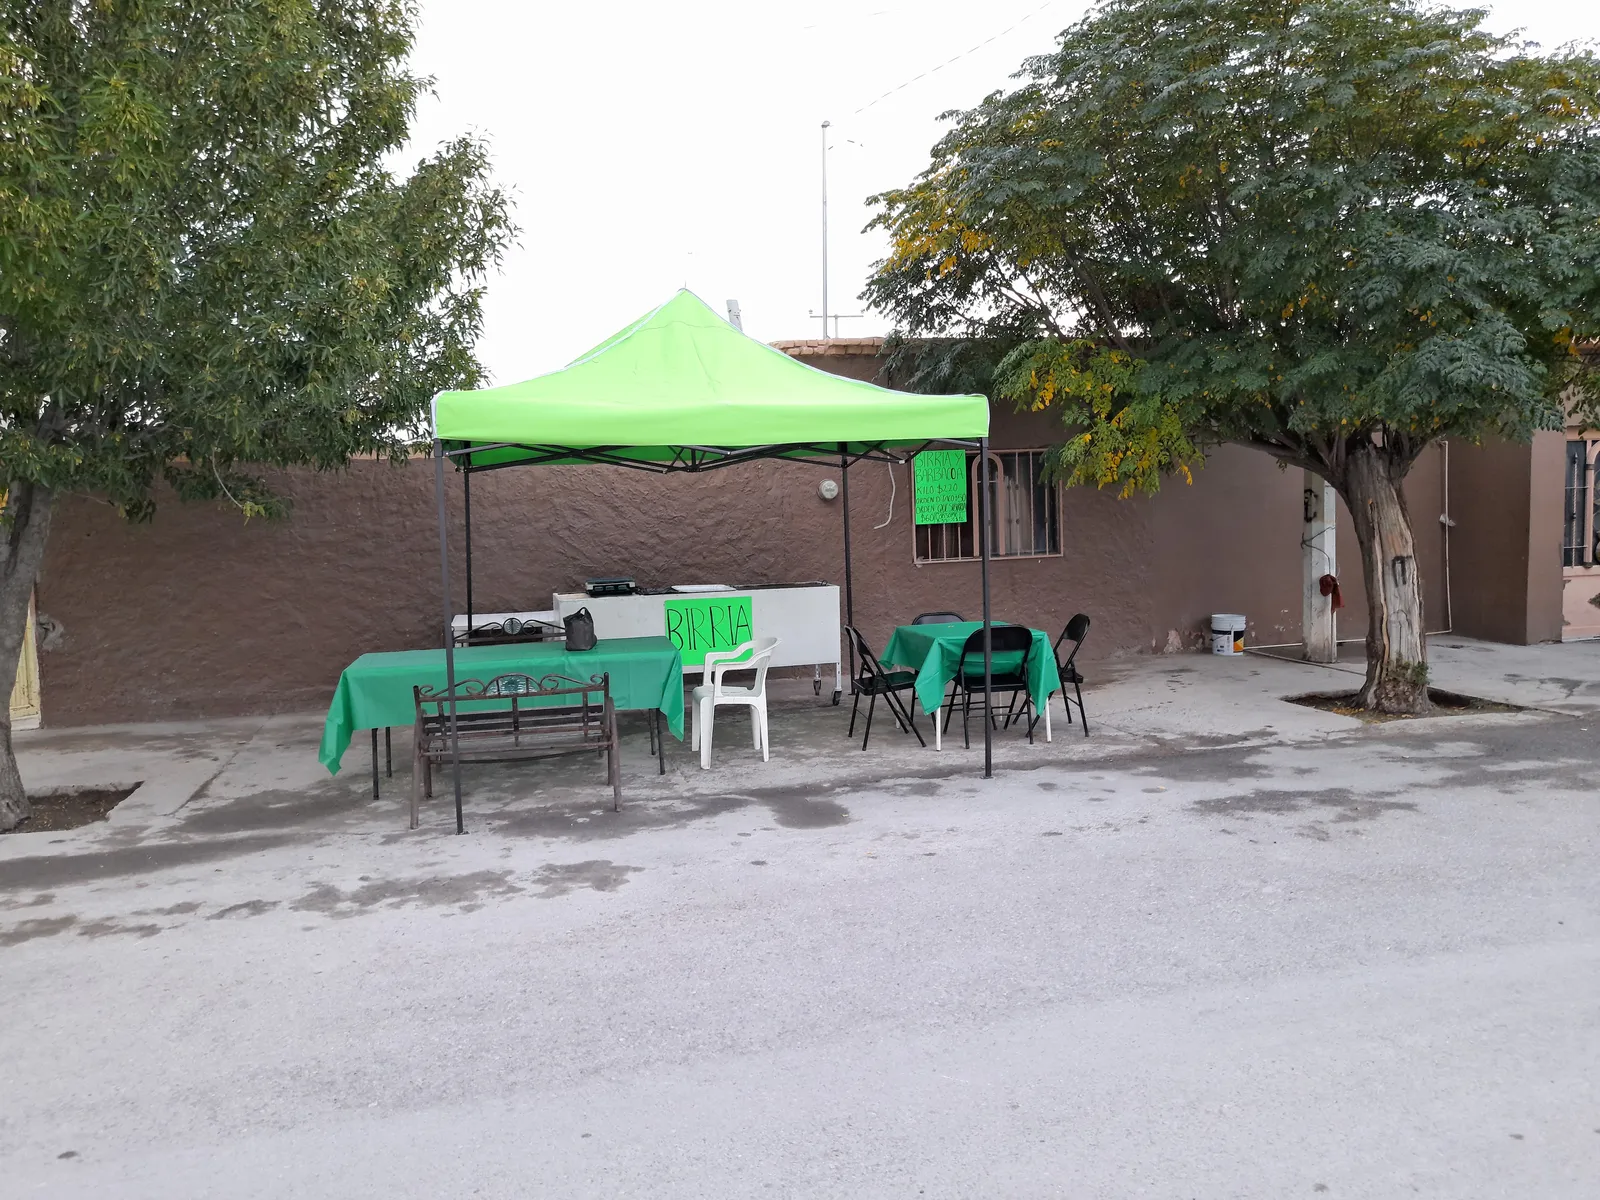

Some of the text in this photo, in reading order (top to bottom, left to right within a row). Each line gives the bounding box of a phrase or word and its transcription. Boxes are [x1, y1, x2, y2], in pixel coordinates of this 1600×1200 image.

[915, 451, 963, 467] BIRRIA Y
[916, 467, 964, 483] BARBACOA
[916, 483, 958, 495] KILO $220
[667, 605, 752, 650] BIRRIA
